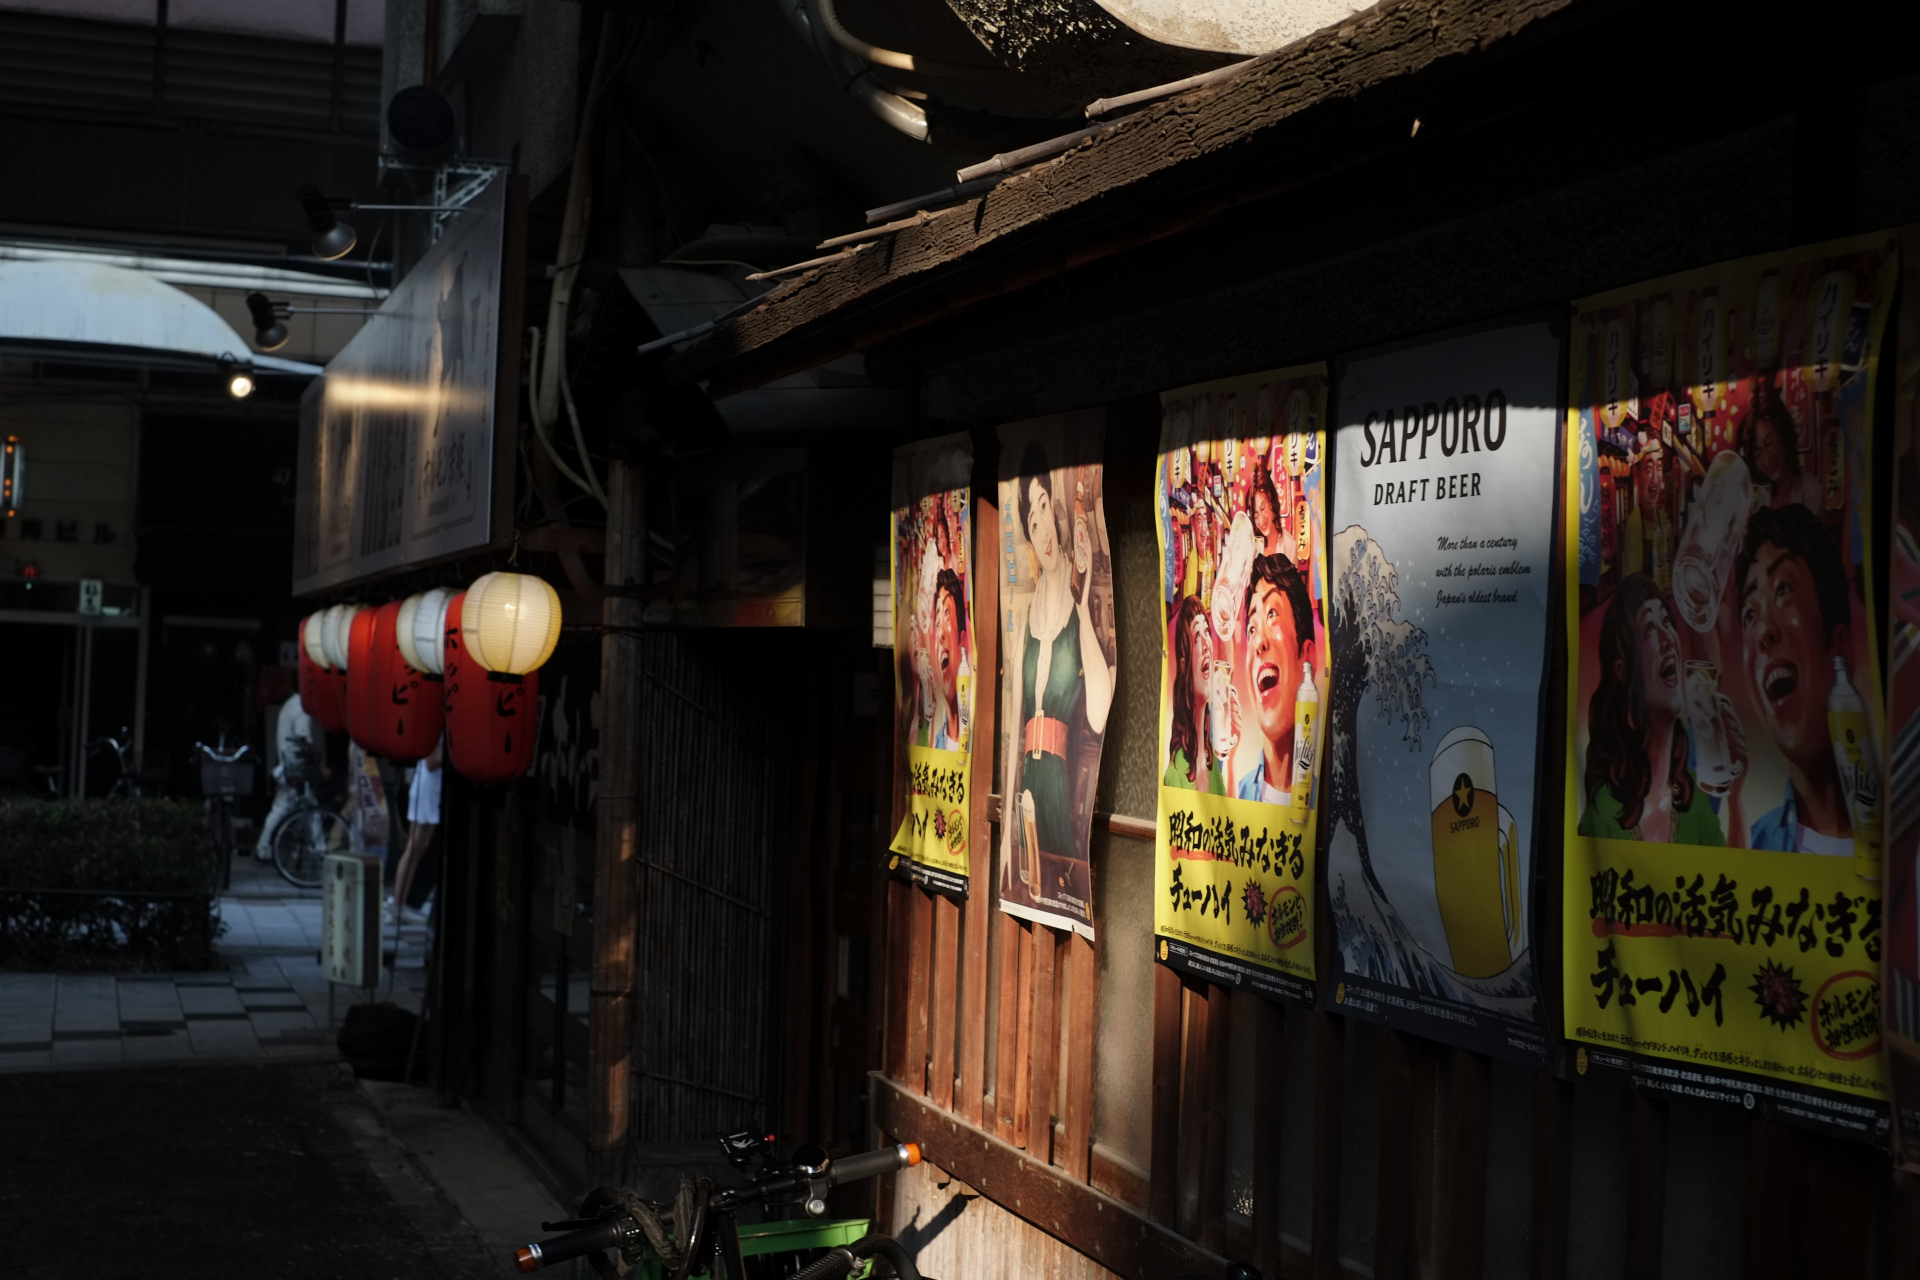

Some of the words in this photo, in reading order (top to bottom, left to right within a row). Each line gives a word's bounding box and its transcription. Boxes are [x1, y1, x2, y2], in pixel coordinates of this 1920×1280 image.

[1702, 308, 1715, 400] ハイリキ
[1814, 283, 1838, 380] ハイリキ
[1607, 331, 1619, 417] ハイリキ
[1225, 408, 1236, 474] ハイリキ
[1289, 398, 1302, 467] ハイリキ
[1360, 388, 1507, 468] SAPPORO
[1373, 478, 1430, 506] DRAFT
[1436, 472, 1482, 500] BEER
[1435, 564, 1453, 578] with
[1453, 564, 1468, 577] the
[1468, 564, 1497, 580] polaris
[1498, 564, 1532, 576] emblem
[1437, 537, 1459, 551] More
[1460, 537, 1478, 550] than
[1479, 540, 1486, 549] a
[1486, 537, 1518, 552] century
[1435, 589, 1466, 608] Japan's
[1468, 590, 1492, 604] oldest
[1492, 590, 1518, 604] brand
[1168, 808, 1305, 880] 昭和の活気みなぎる
[1449, 816, 1480, 834] SAPPORO
[1169, 861, 1232, 926] チューハイ
[1271, 895, 1301, 927] ホルモンと
[1589, 866, 1881, 962] 昭和の活気みなぎる
[1590, 939, 1727, 1027] チューハイ
[1818, 983, 1881, 1028] ホルモンと
